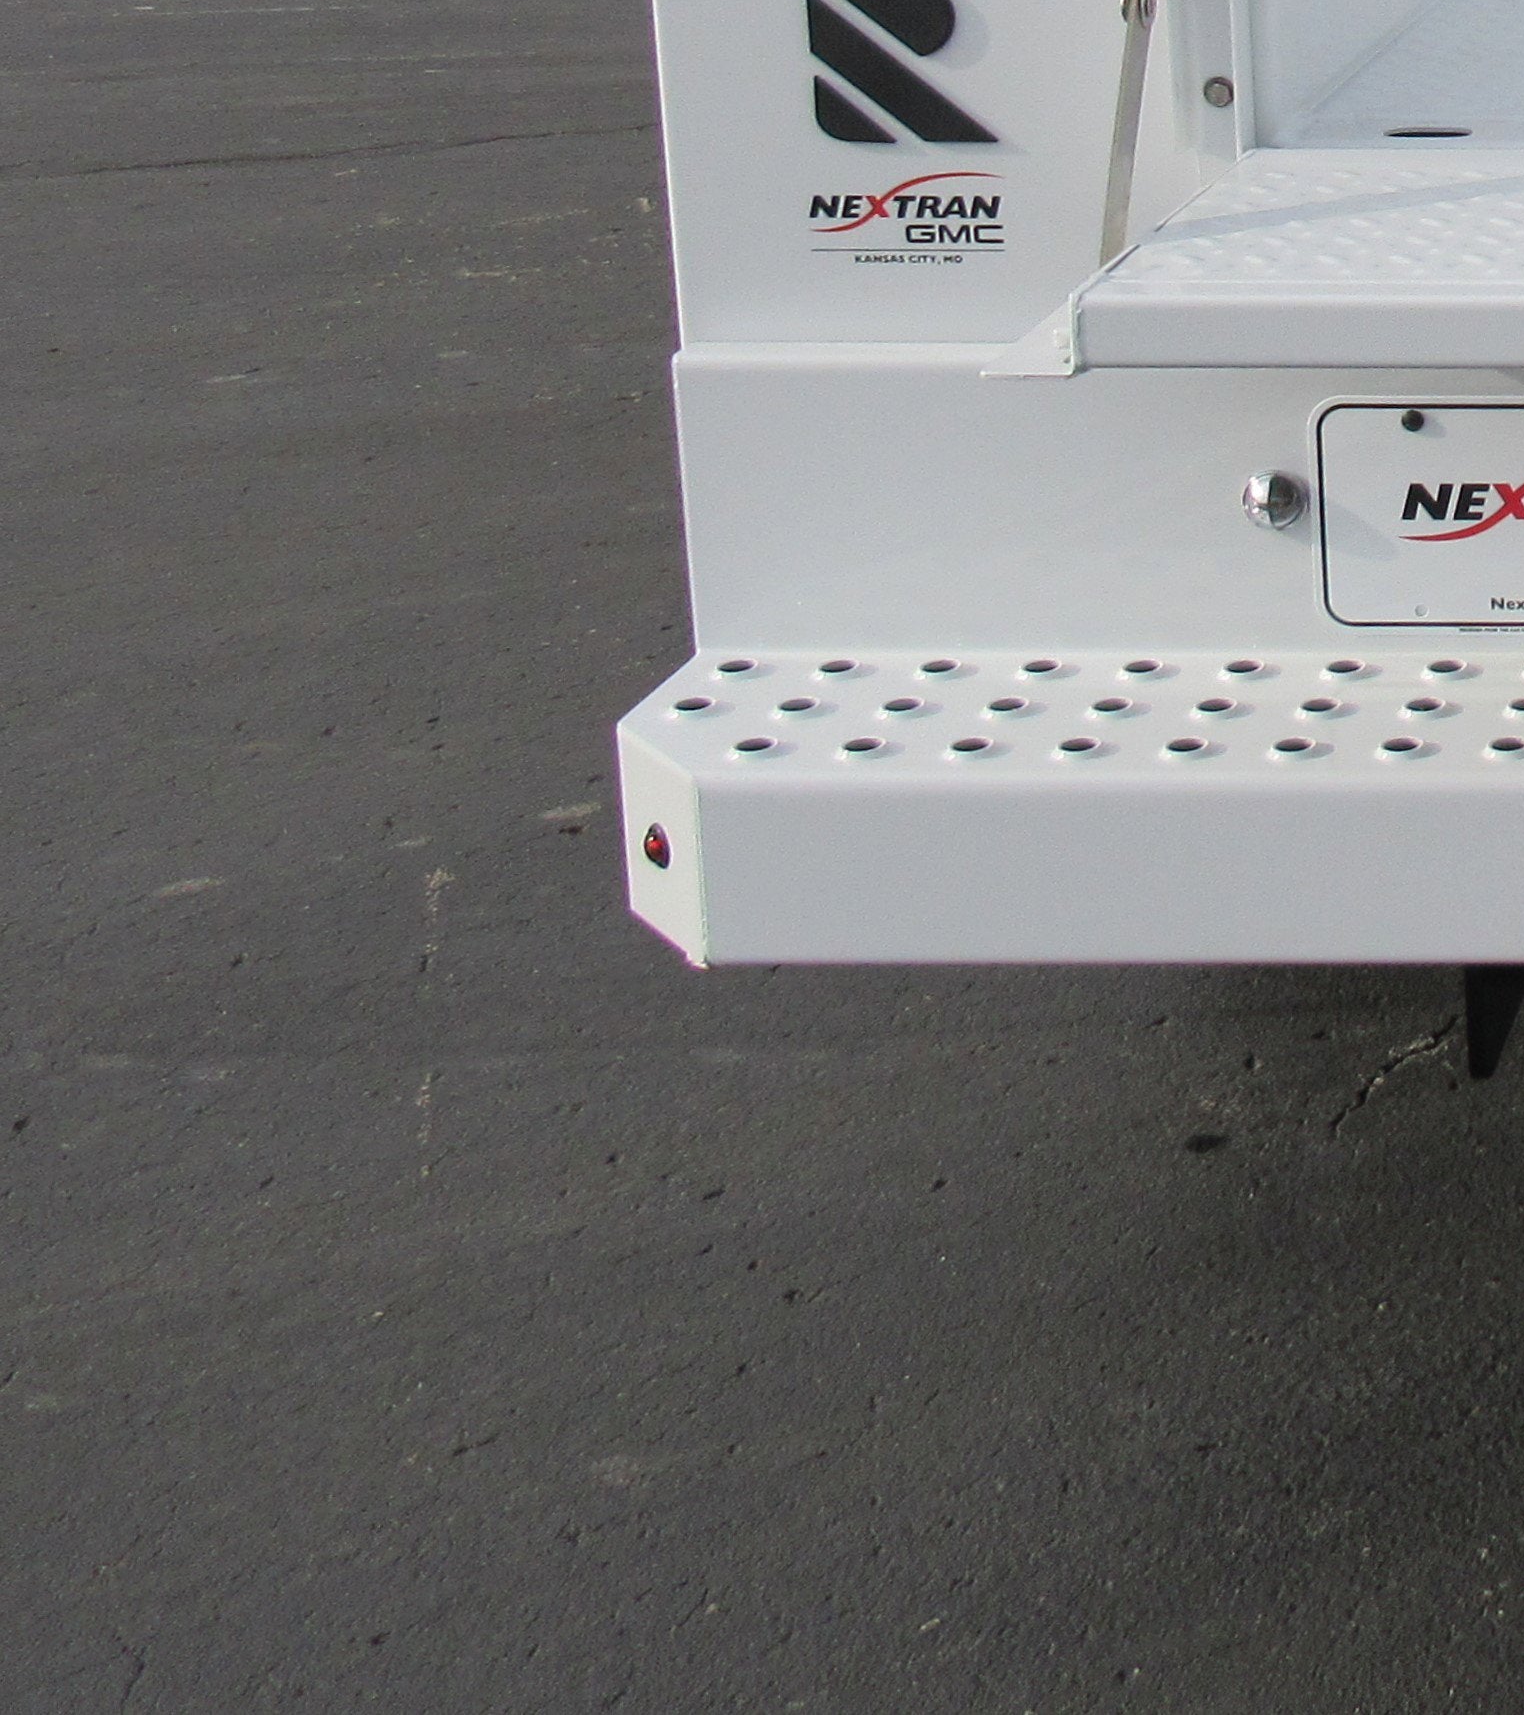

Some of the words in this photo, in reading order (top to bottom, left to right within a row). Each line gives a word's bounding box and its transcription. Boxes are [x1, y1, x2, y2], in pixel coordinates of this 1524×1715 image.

[808, 195, 1001, 219] NEXTRAN
[904, 224, 1005, 244] GMC
[854, 254, 905, 264] KANSAS
[943, 254, 964, 264] MO
